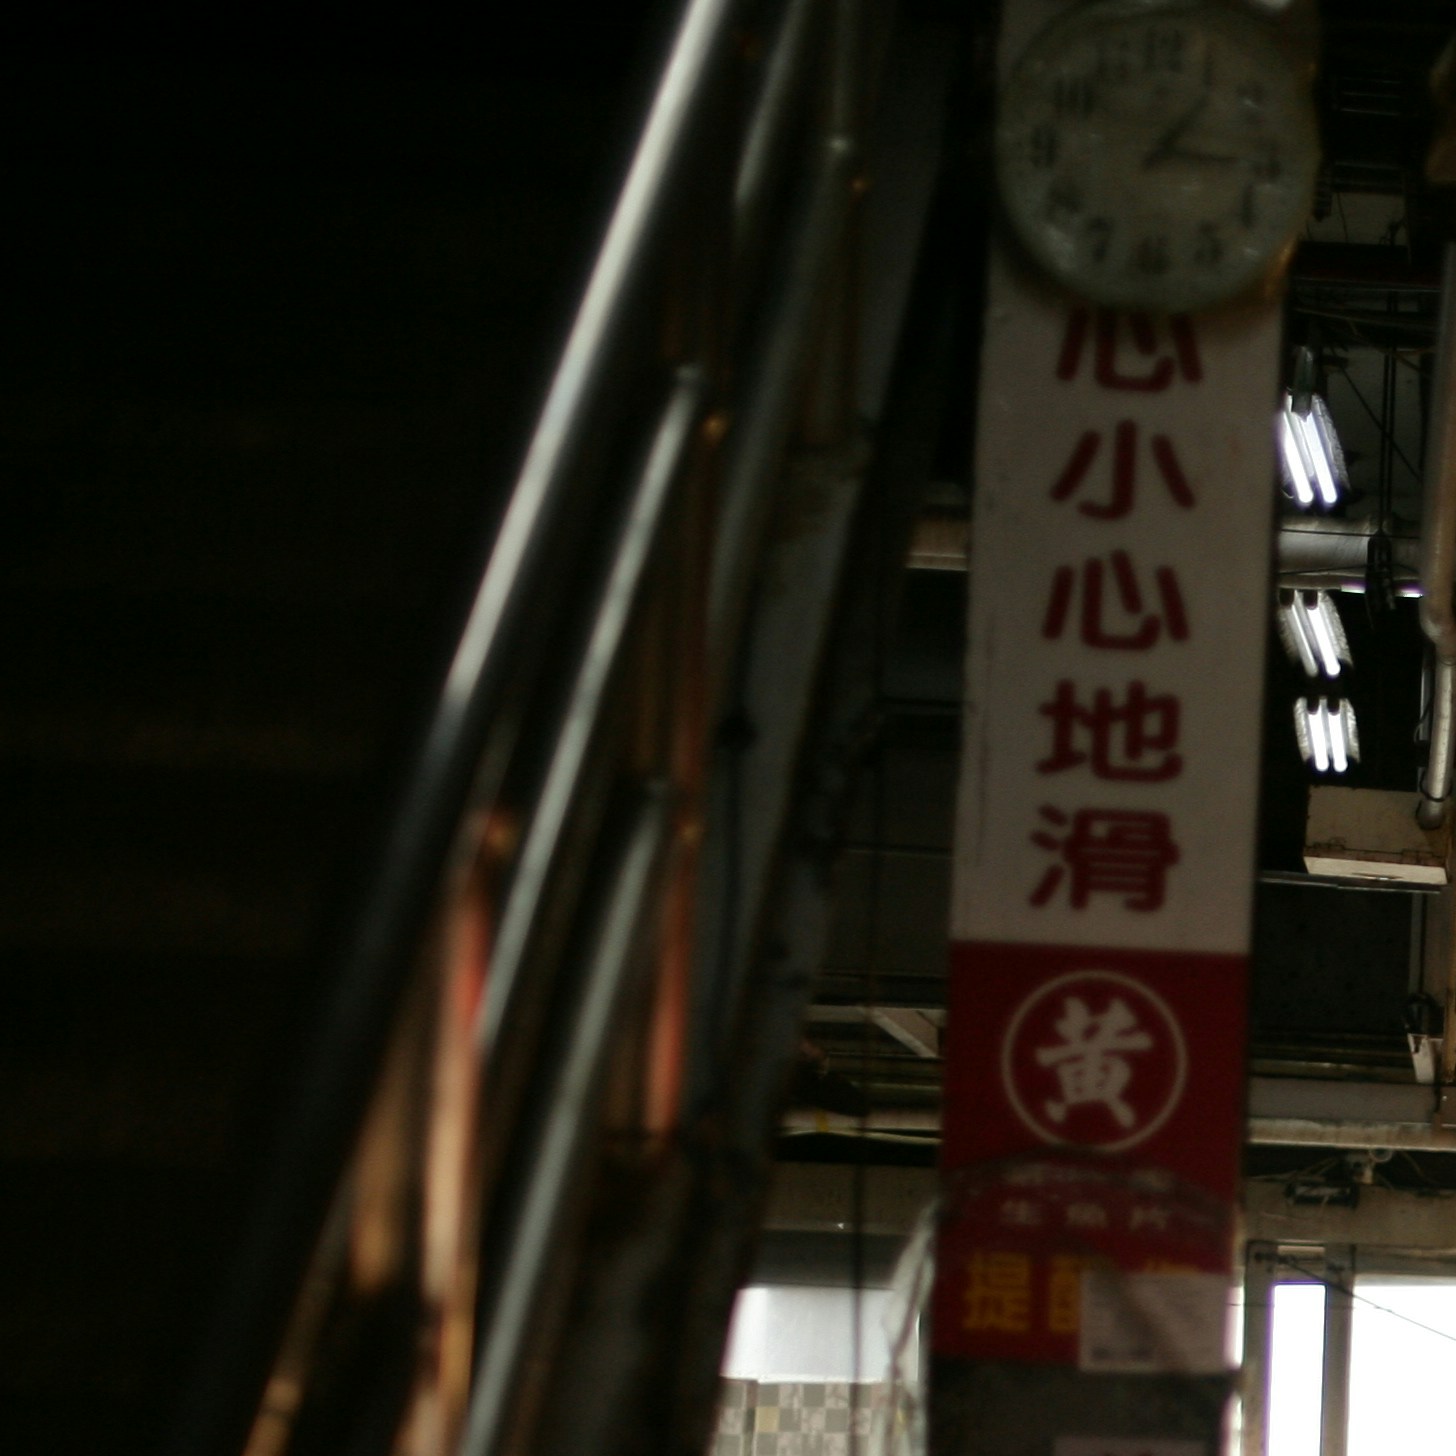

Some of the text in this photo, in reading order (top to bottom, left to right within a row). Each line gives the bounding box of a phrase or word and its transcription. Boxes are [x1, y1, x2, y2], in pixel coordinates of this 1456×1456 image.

[1029, 307, 1204, 910] 心小心地滑
[1035, 997, 1154, 1129] 黃
